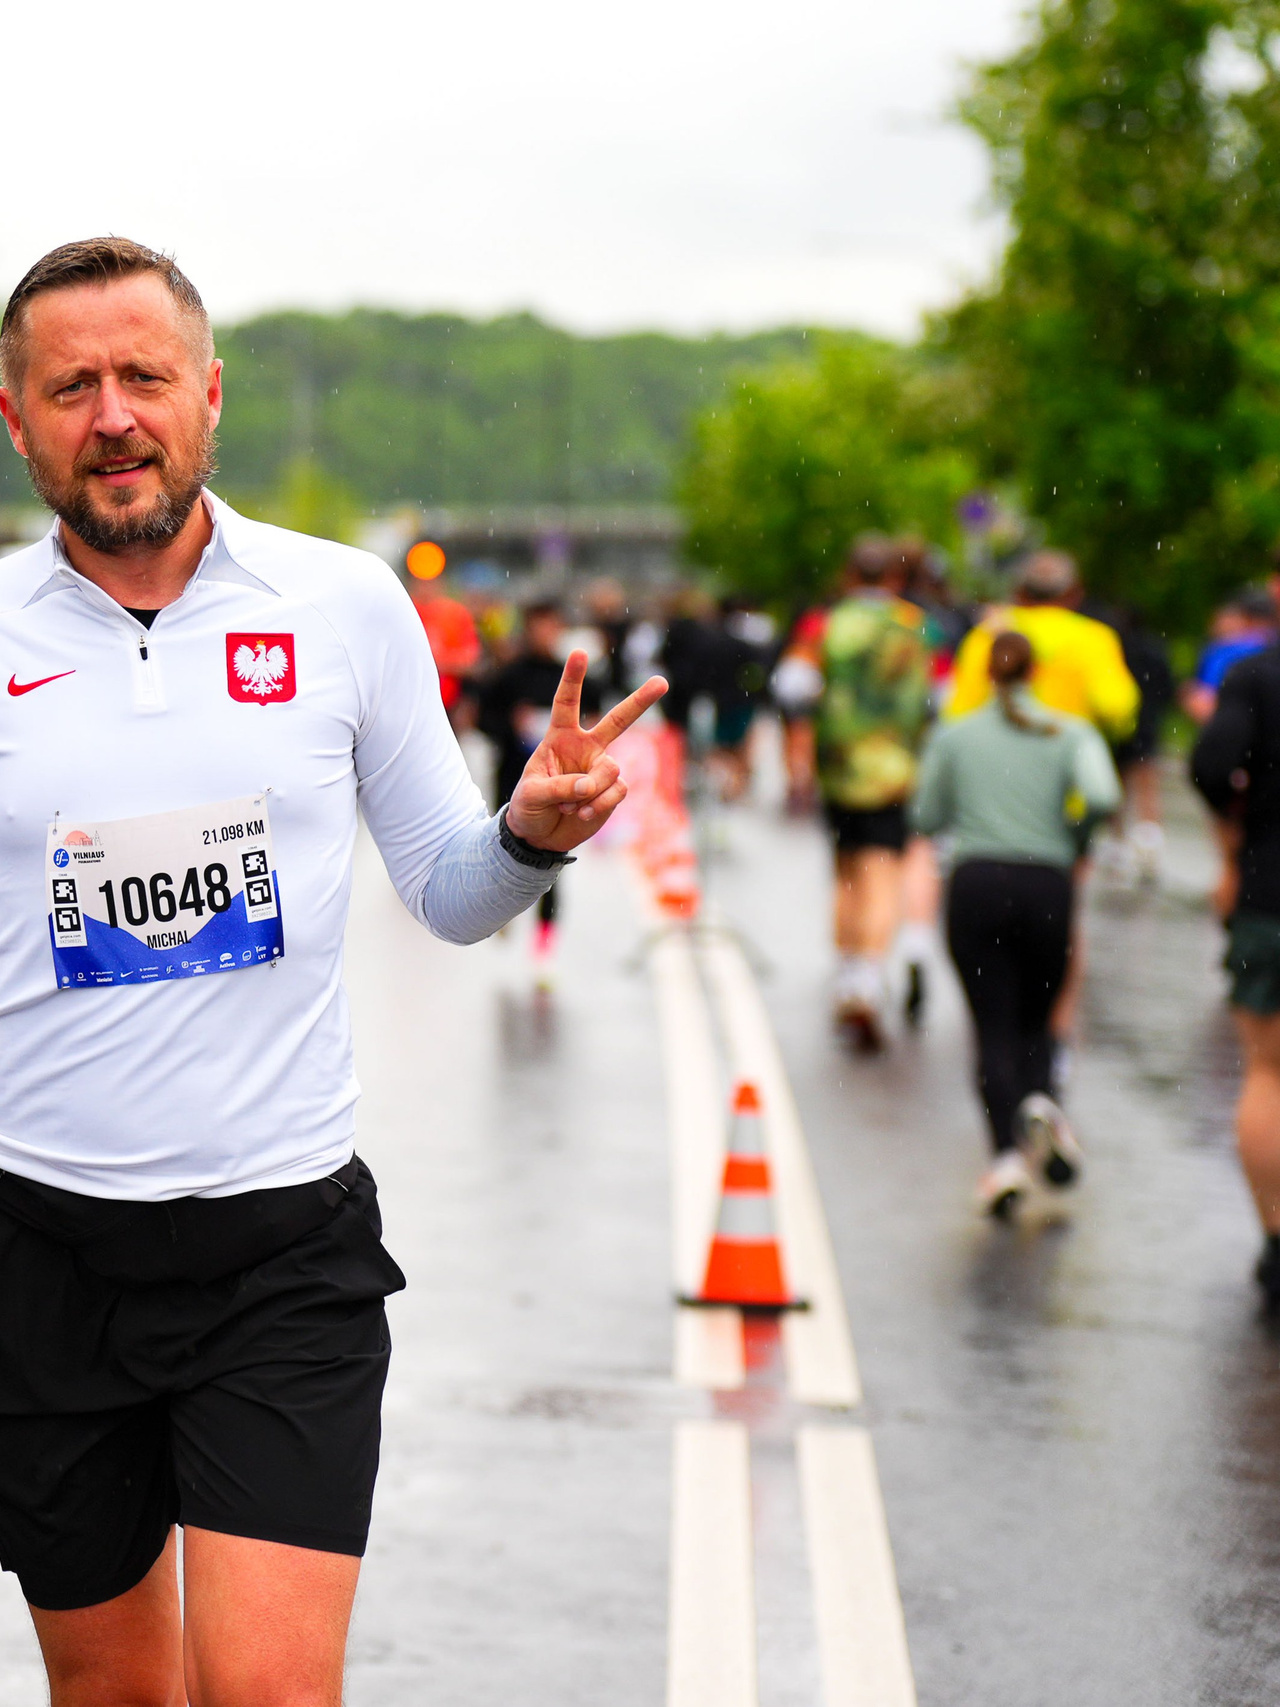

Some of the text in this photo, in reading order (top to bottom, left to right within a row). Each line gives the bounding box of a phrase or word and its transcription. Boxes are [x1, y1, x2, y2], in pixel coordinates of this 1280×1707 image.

[202, 820, 265, 845] 21,098 KM
[73, 850, 105, 860] VILNIAUS
[98, 862, 232, 929] 10648
[146, 929, 192, 950] MICHAL
